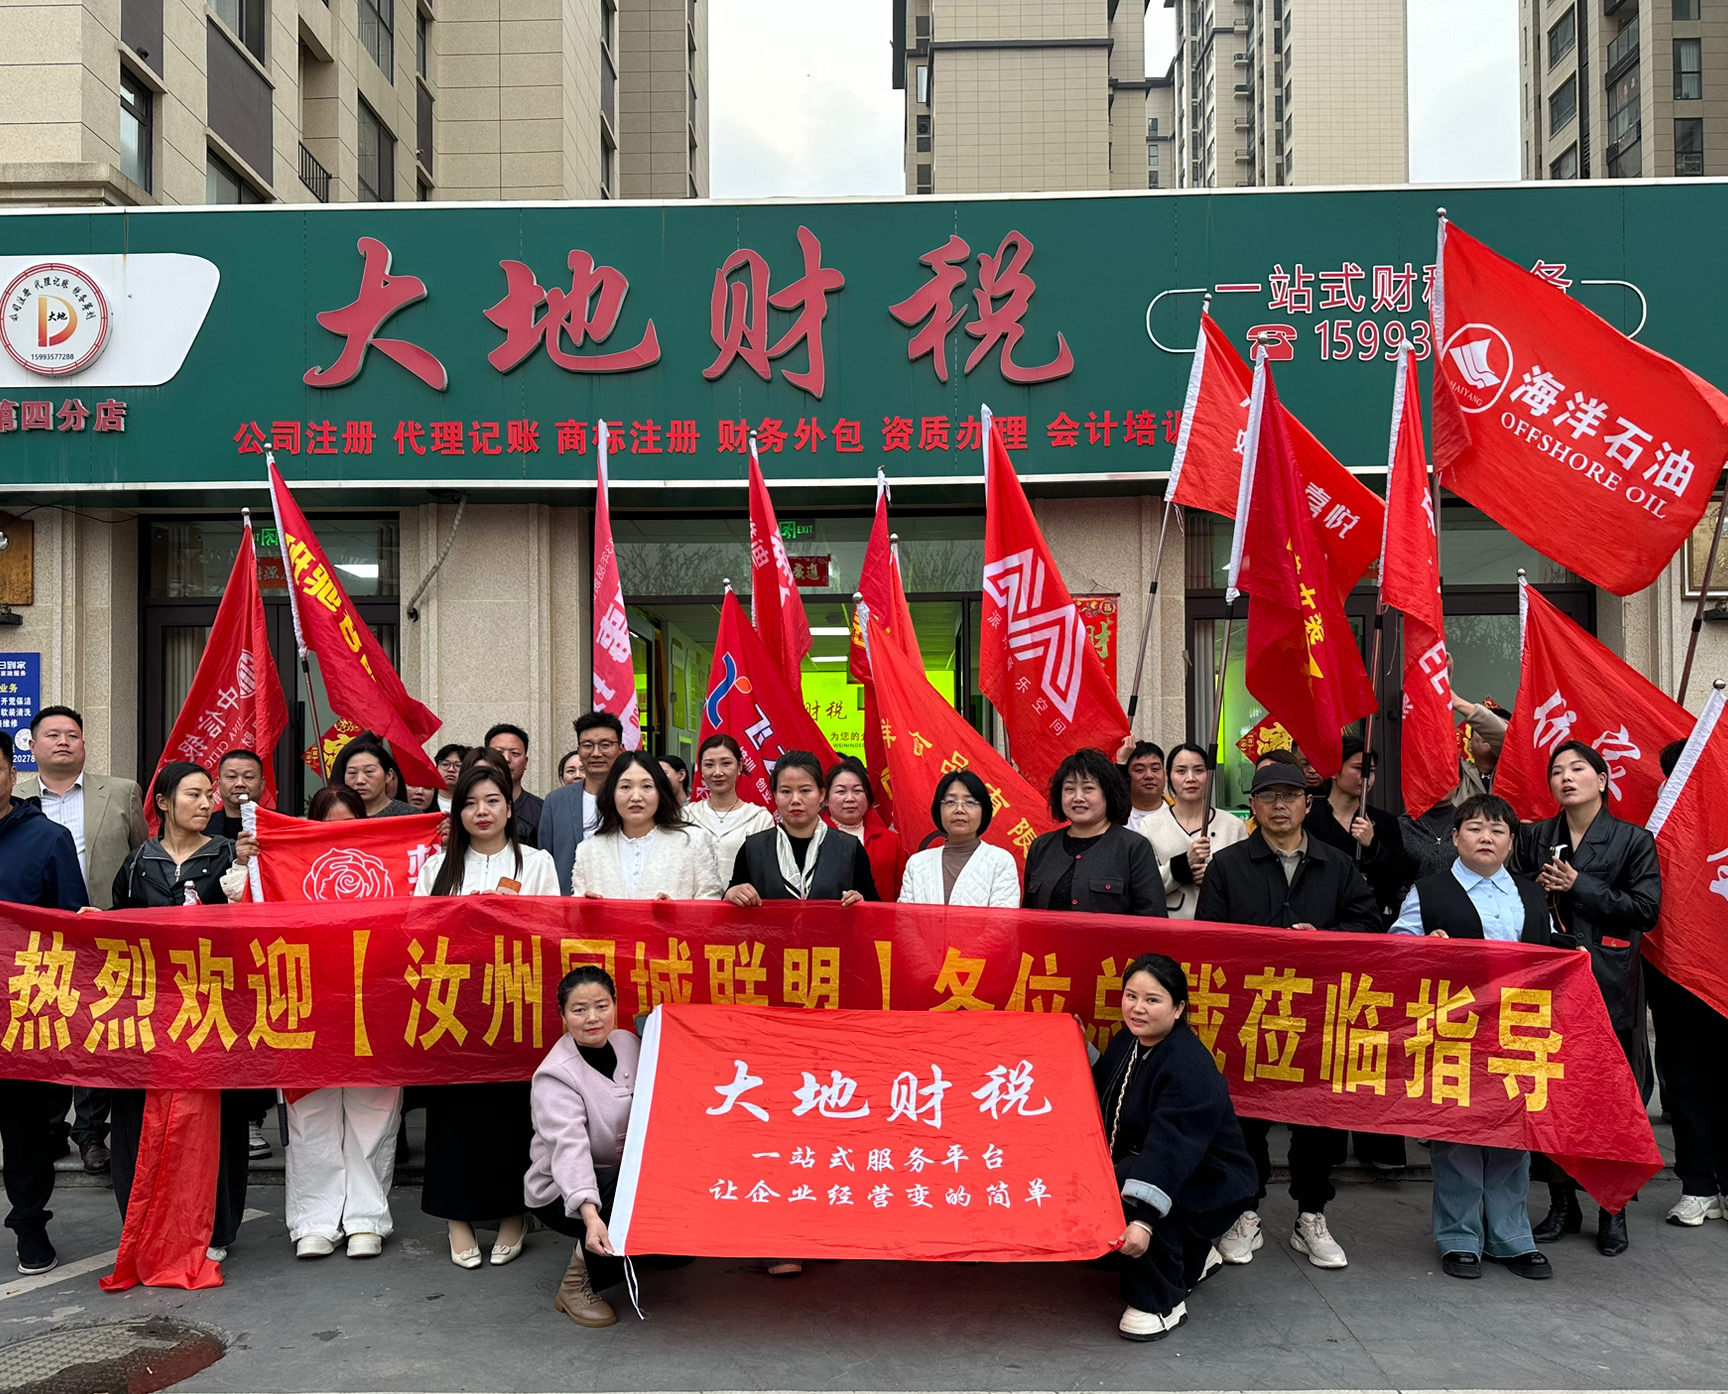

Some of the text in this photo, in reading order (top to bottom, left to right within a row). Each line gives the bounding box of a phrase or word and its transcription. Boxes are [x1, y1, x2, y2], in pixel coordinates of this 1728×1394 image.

[302, 226, 1075, 399] 大地财税
[233, 421, 377, 456] 公司注册
[393, 419, 541, 456] 代理记账
[717, 417, 865, 455] 财务外包
[1509, 364, 1696, 498] 海洋石油
[1500, 410, 1666, 519] OFFSHORE OIL
[797, 525, 813, 534] EXIT
[705, 1059, 1052, 1130] 大地财税
[751, 1142, 1007, 1175] 一站式服务平台
[708, 1177, 1053, 1210] 让企业经营变的简单
